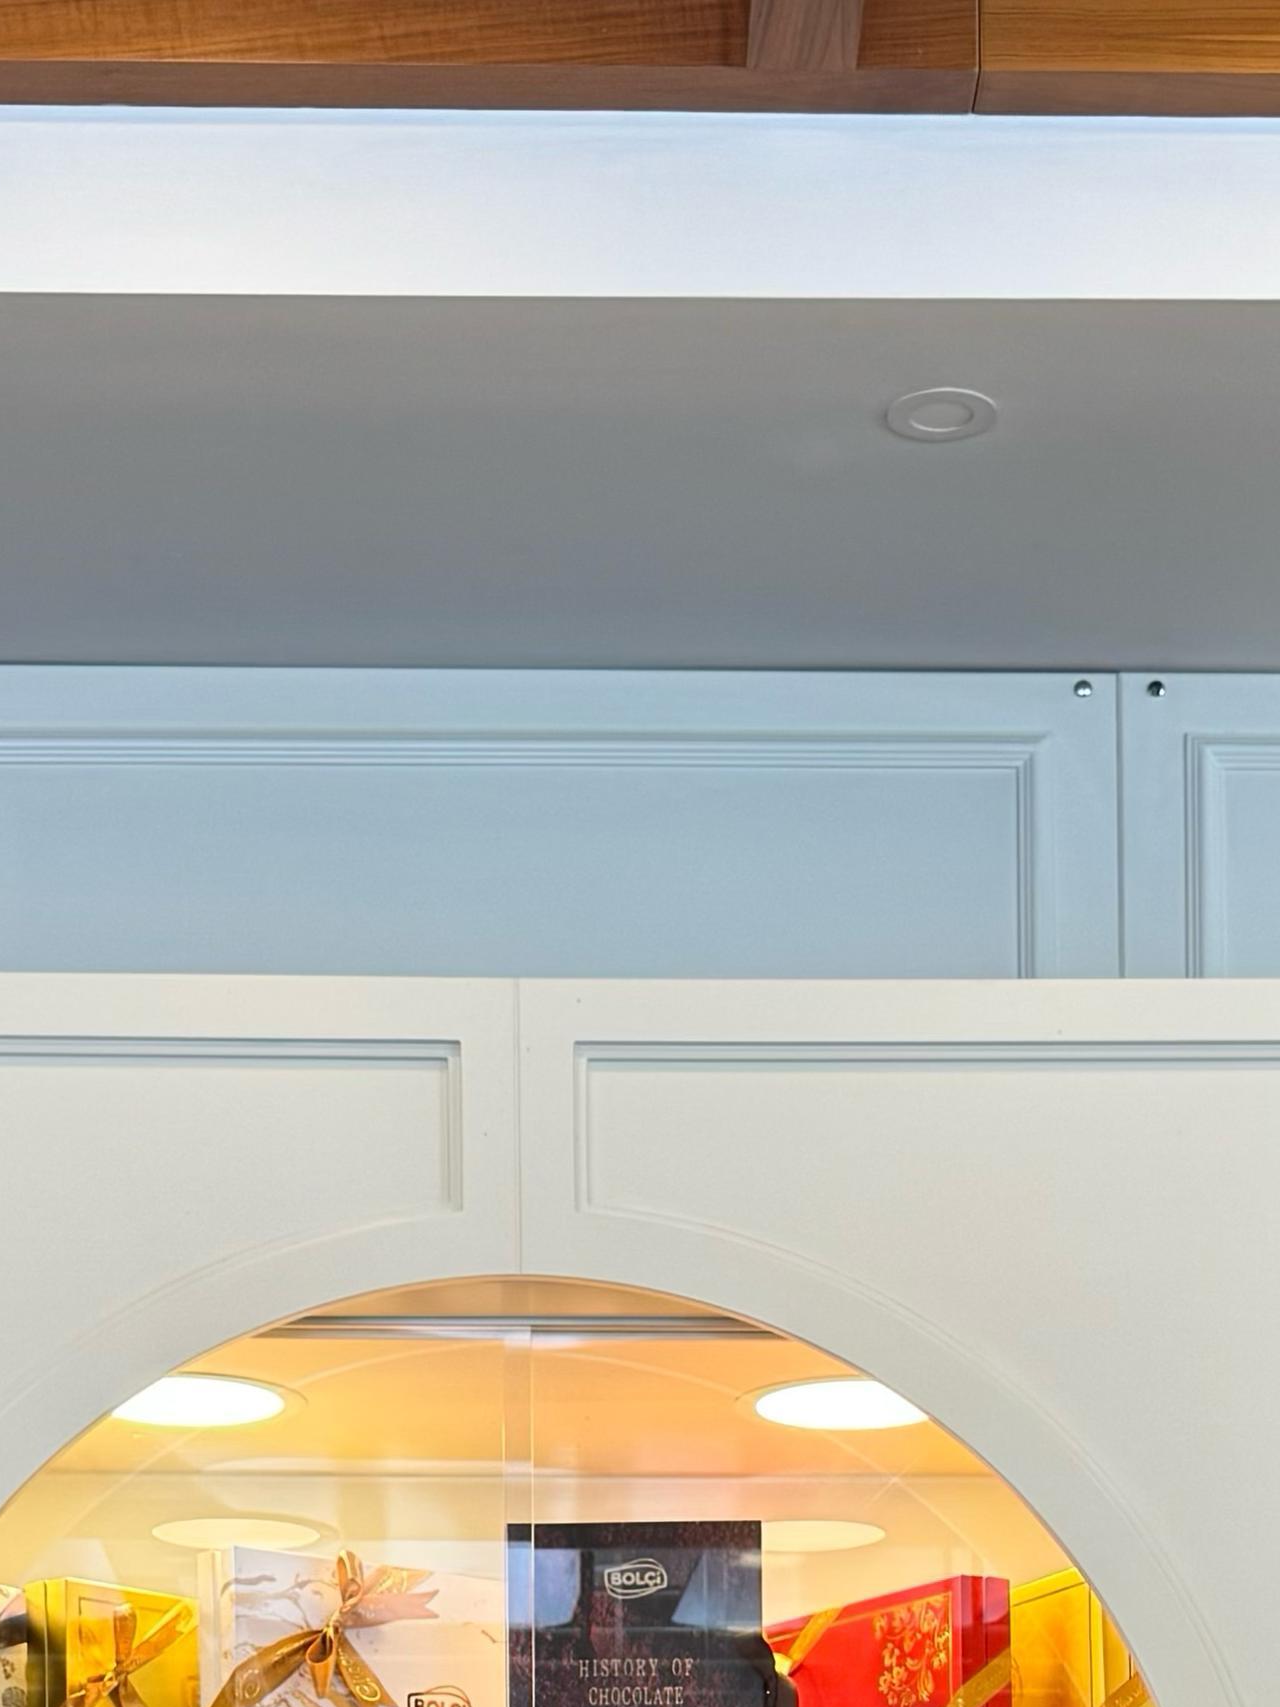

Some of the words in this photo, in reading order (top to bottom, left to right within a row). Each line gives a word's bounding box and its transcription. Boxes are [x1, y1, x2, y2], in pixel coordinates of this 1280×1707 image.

[579, 1658, 658, 1678] HISTORY
[671, 1657, 694, 1676] OF
[588, 1686, 684, 1705] CHOCOLATE
